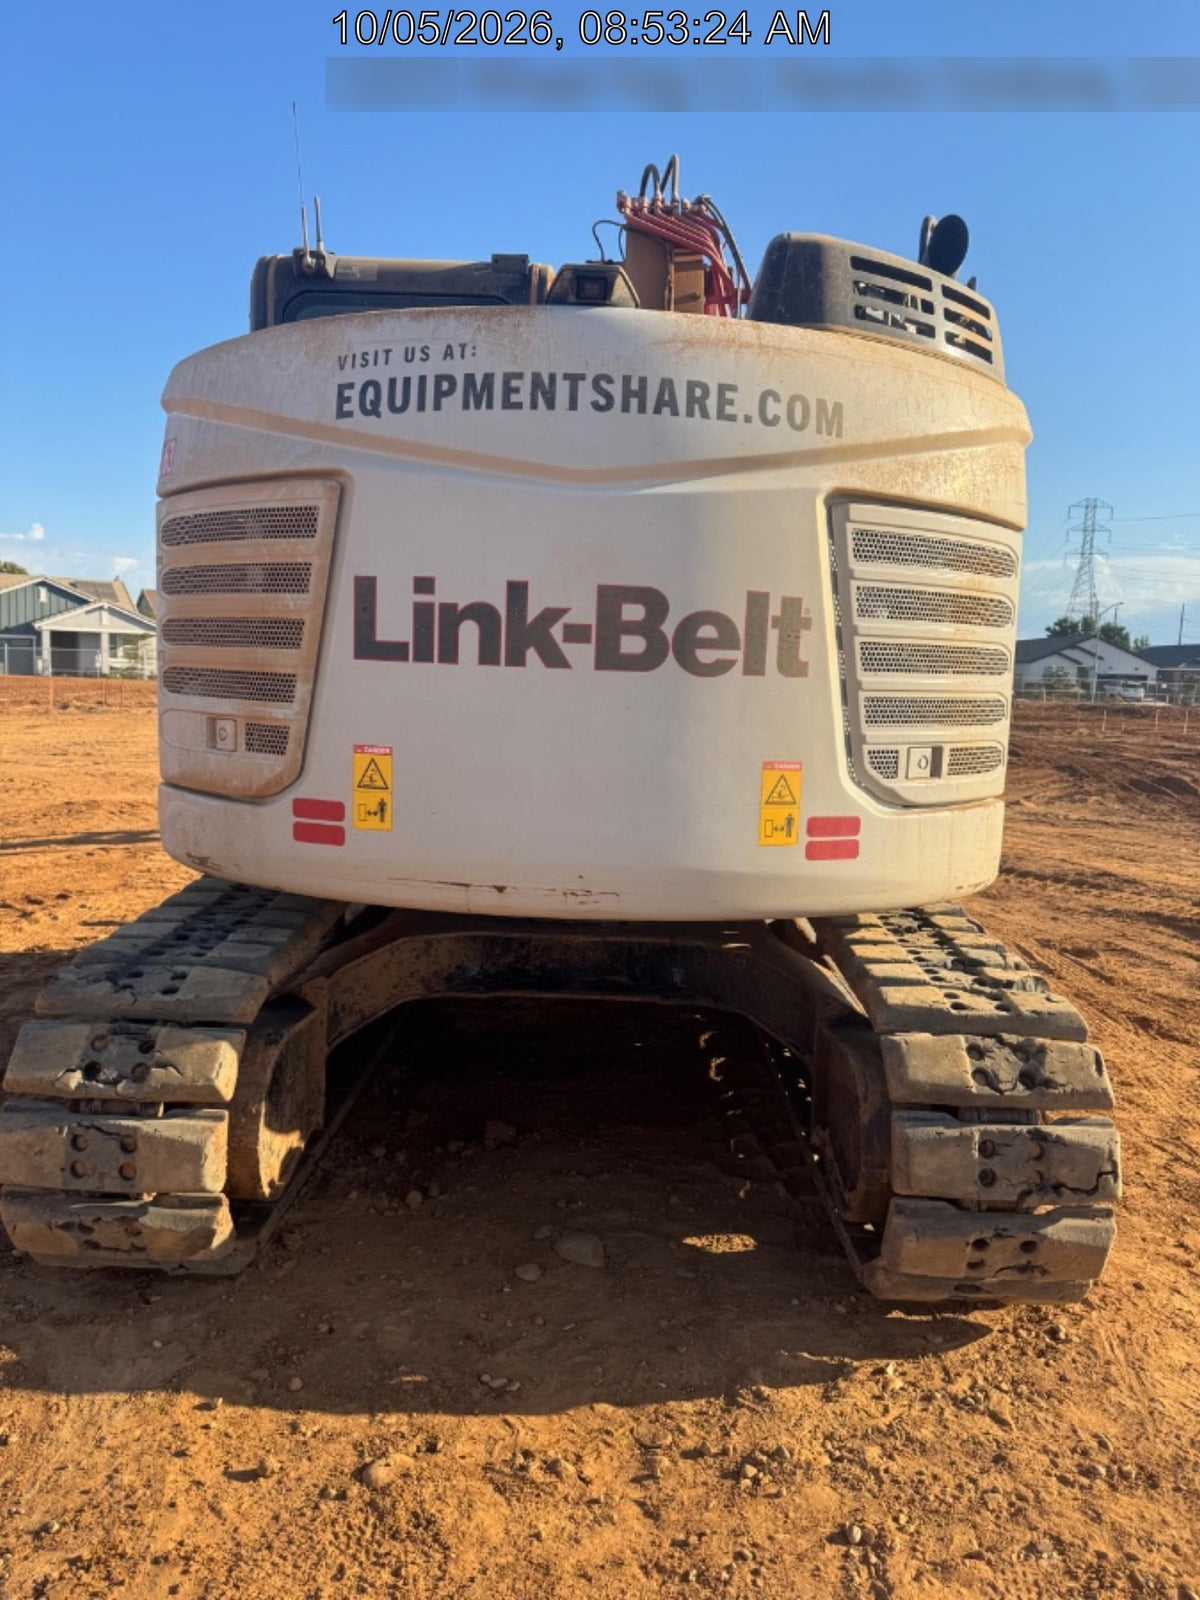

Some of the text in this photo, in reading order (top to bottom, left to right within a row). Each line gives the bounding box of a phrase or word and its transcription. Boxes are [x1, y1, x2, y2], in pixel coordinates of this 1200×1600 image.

[338, 343, 477, 371] VISIT US AT:
[335, 371, 845, 439] EQUIPMENTSHARE.COM
[353, 575, 812, 678] Link-Belt
